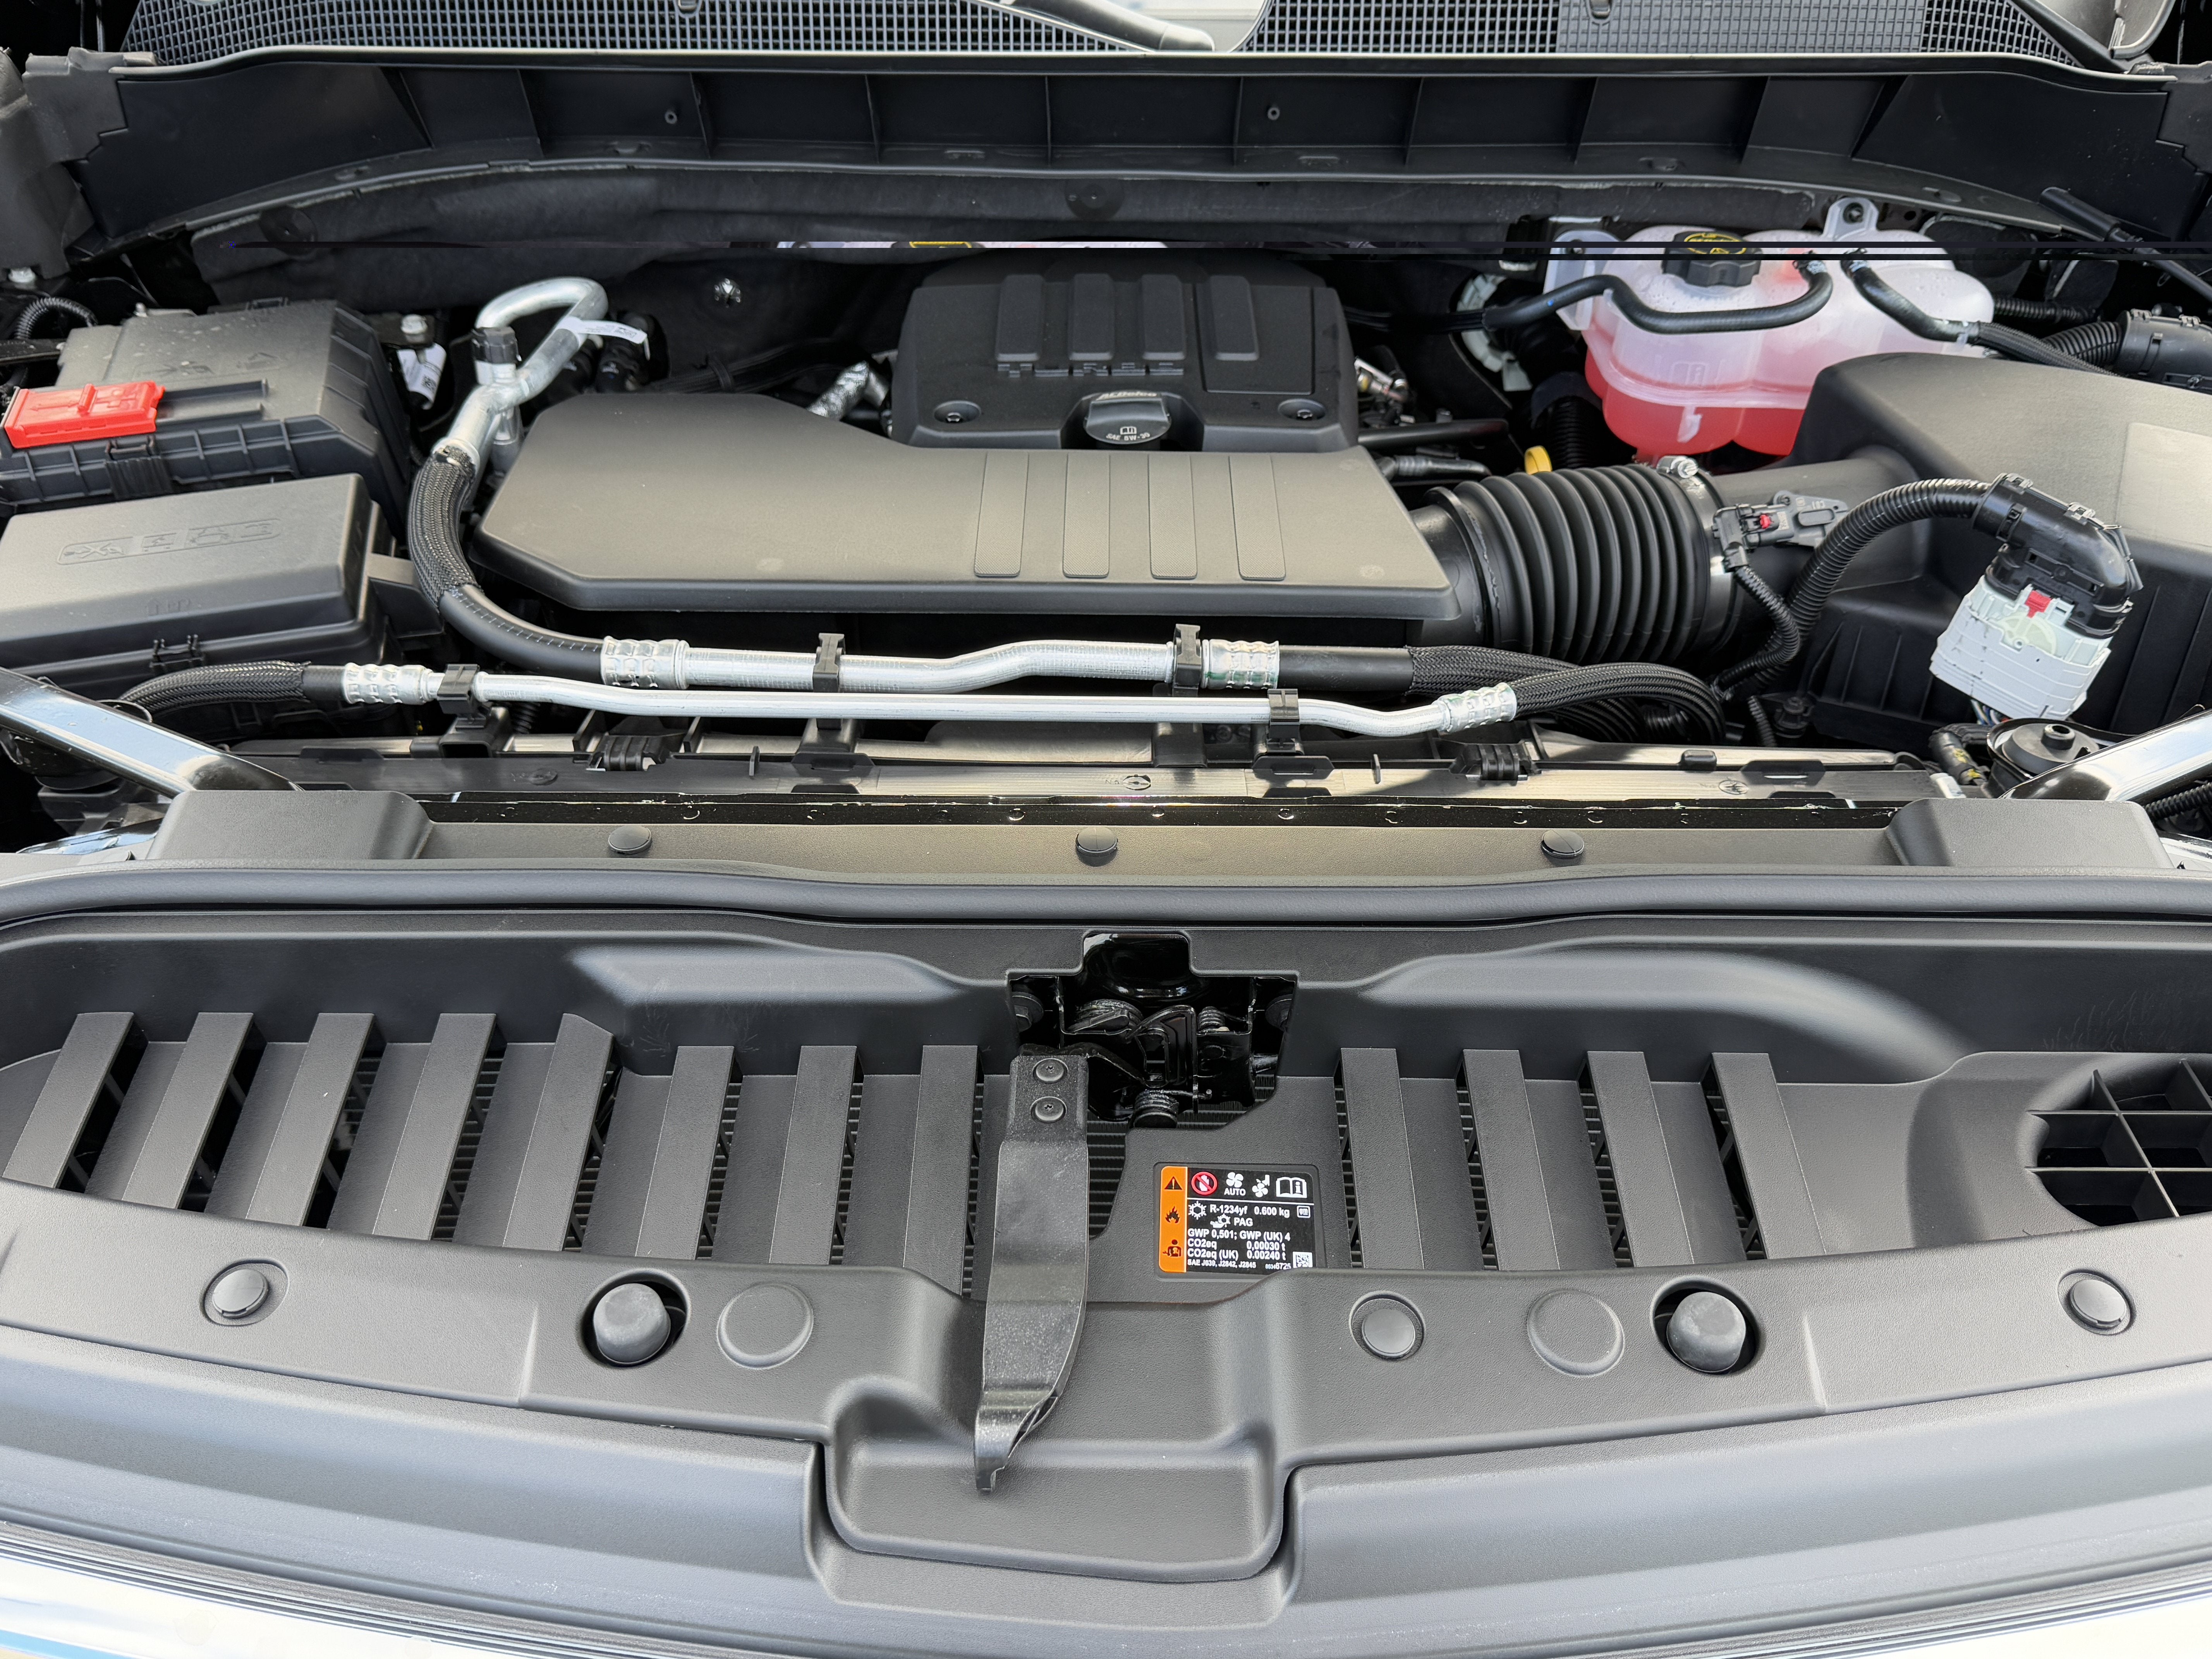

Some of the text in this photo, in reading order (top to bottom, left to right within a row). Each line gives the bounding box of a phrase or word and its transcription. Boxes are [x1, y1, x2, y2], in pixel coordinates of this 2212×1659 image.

[1224, 1188, 1246, 1196] AUTO
[1210, 1204, 1290, 1218] R-1234yf 0.600 kg
[1234, 1217, 1253, 1226] PAG
[1187, 1228, 1291, 1243] GWP 0,501; GWP (UK) 4
[1187, 1238, 1217, 1250] CO2eq
[1281, 1242, 1285, 1251] t
[1187, 1248, 1286, 1261] CO2eq (UK) 0.00240 t
